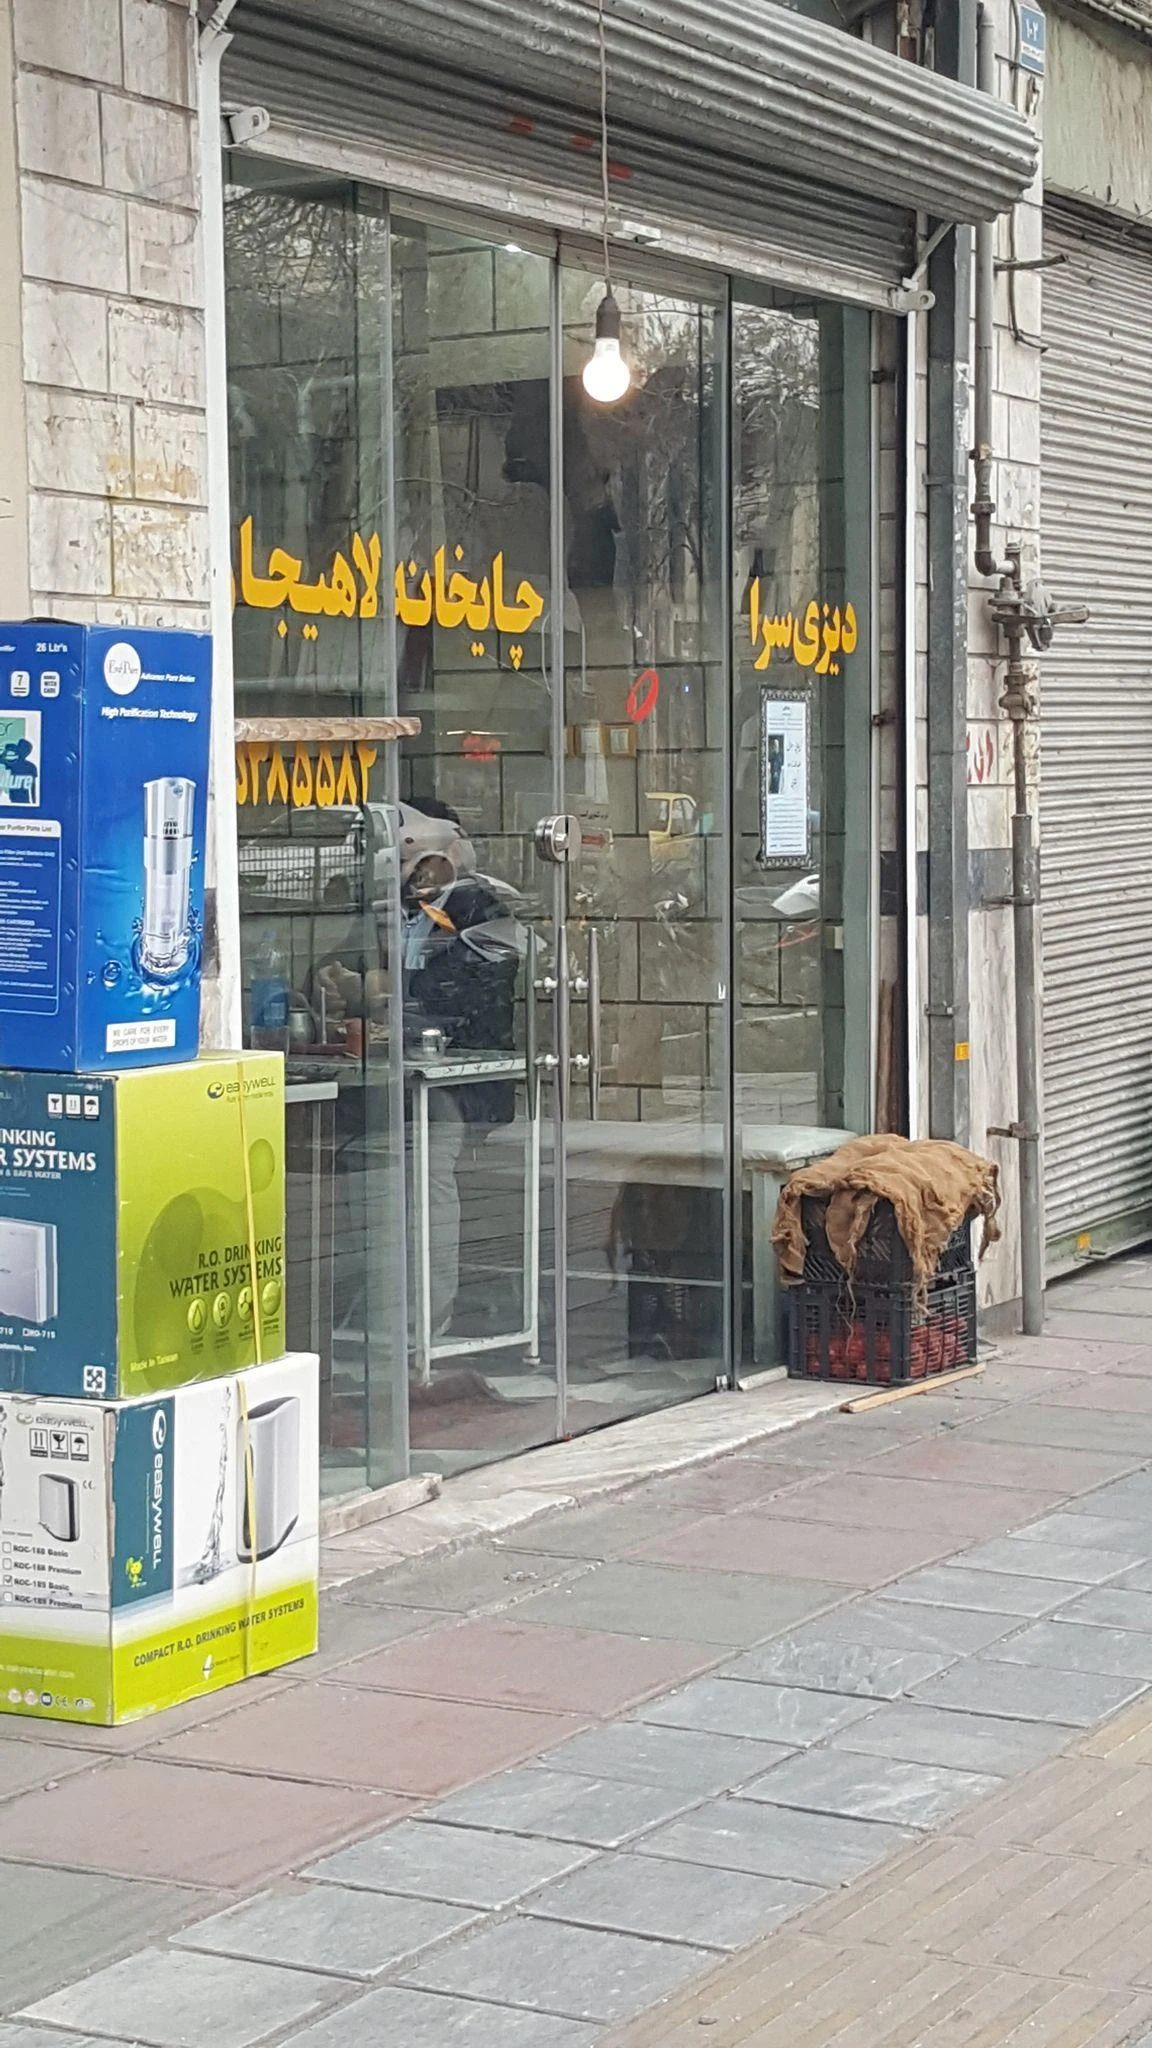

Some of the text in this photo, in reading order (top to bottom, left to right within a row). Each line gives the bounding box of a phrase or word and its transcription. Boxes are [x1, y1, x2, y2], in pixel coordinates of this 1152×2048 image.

[230, 515, 544, 670] چایخانه لاهیجا
[102, 706, 198, 722] High Purification Technology
[13, 1148, 97, 1171] SYSTEMS
[198, 1236, 282, 1269] R.O. DRINKING
[169, 1256, 282, 1298] WATER SYSTEMS
[130, 1360, 148, 1372] Made
[156, 1352, 178, 1365] Taiwan
[47, 1548, 69, 1558] Basic
[48, 1565, 82, 1575] Premium
[48, 1581, 70, 1591] Basic
[49, 1598, 82, 1609] Premium
[133, 1598, 305, 1667] COMPACT R.O. DRINKING WATER SYSTEMS
